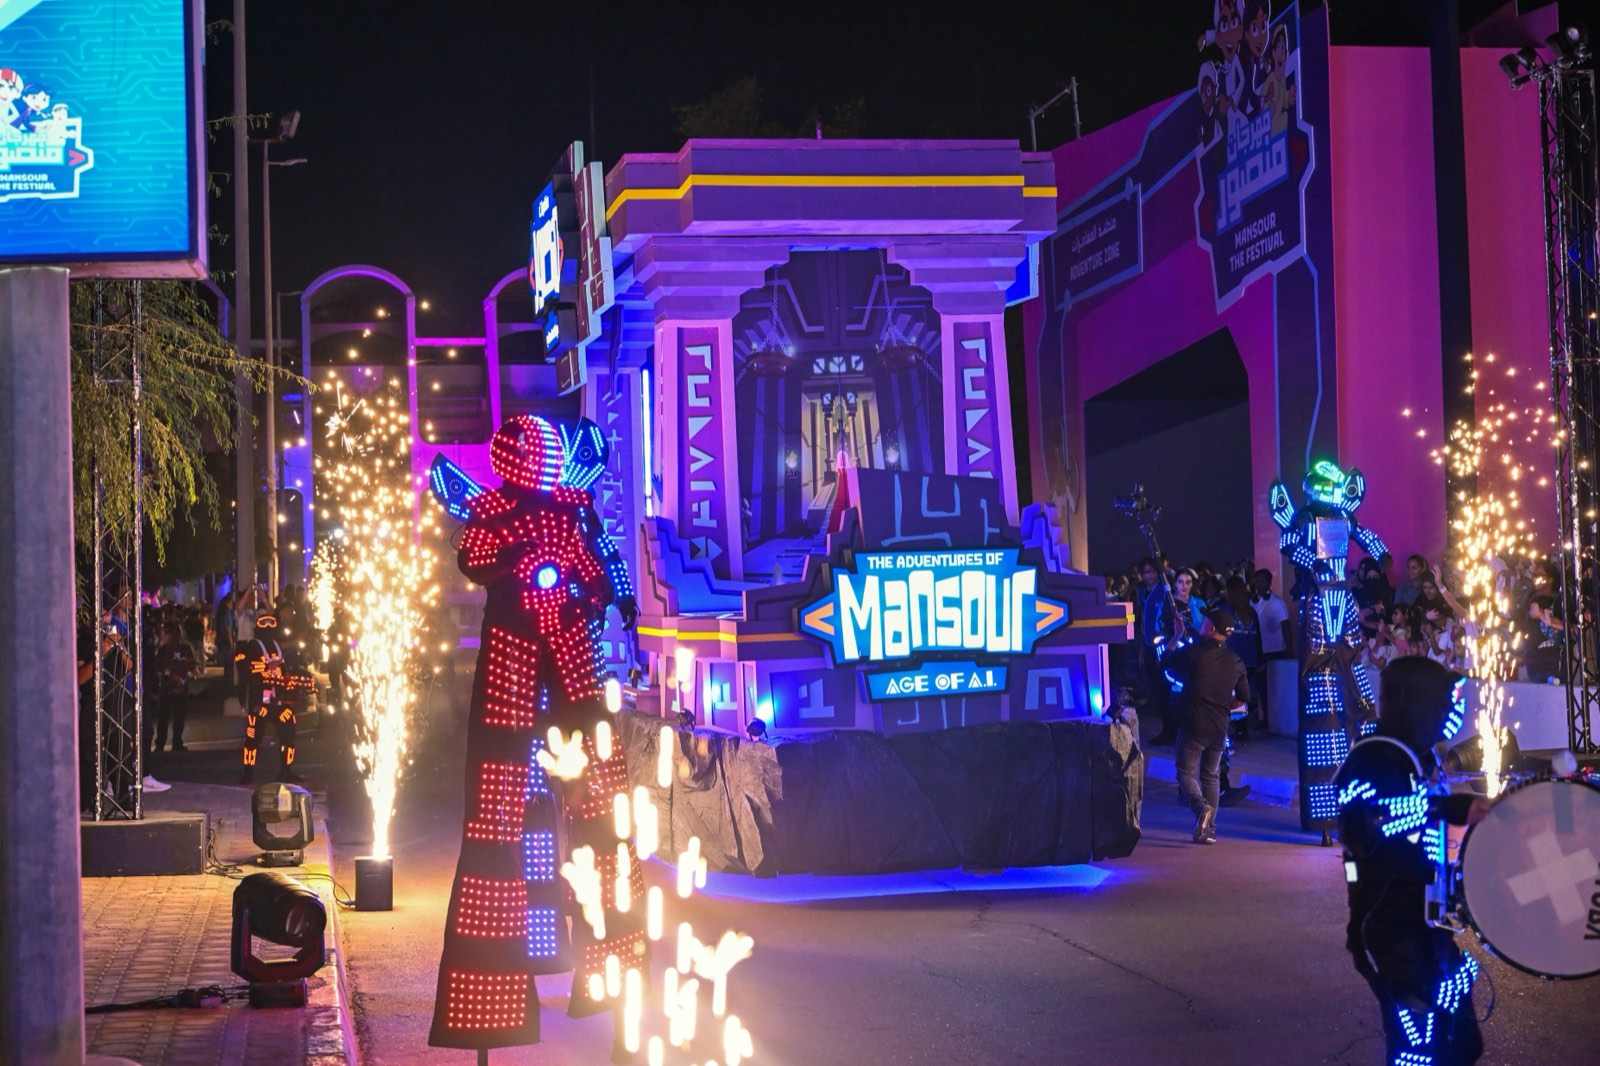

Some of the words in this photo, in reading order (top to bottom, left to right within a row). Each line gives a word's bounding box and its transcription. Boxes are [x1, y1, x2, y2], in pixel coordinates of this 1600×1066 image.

[0, 182, 11, 190] HE
[12, 182, 56, 190] FESTIVAL
[1217, 136, 1288, 230] منصور
[1234, 211, 1277, 250] MANSOUR
[1069, 249, 1103, 282] ADVENTURE
[1103, 241, 1121, 264] ZONE
[1229, 248, 1246, 273] THE
[1245, 229, 1285, 264] FESTIVAL
[867, 556, 893, 570] THE
[896, 553, 983, 568] ADVENTURES
[985, 552, 1004, 566] OF
[886, 674, 930, 695] AGE
[935, 671, 965, 691] OF
[968, 669, 998, 688] A.I.
